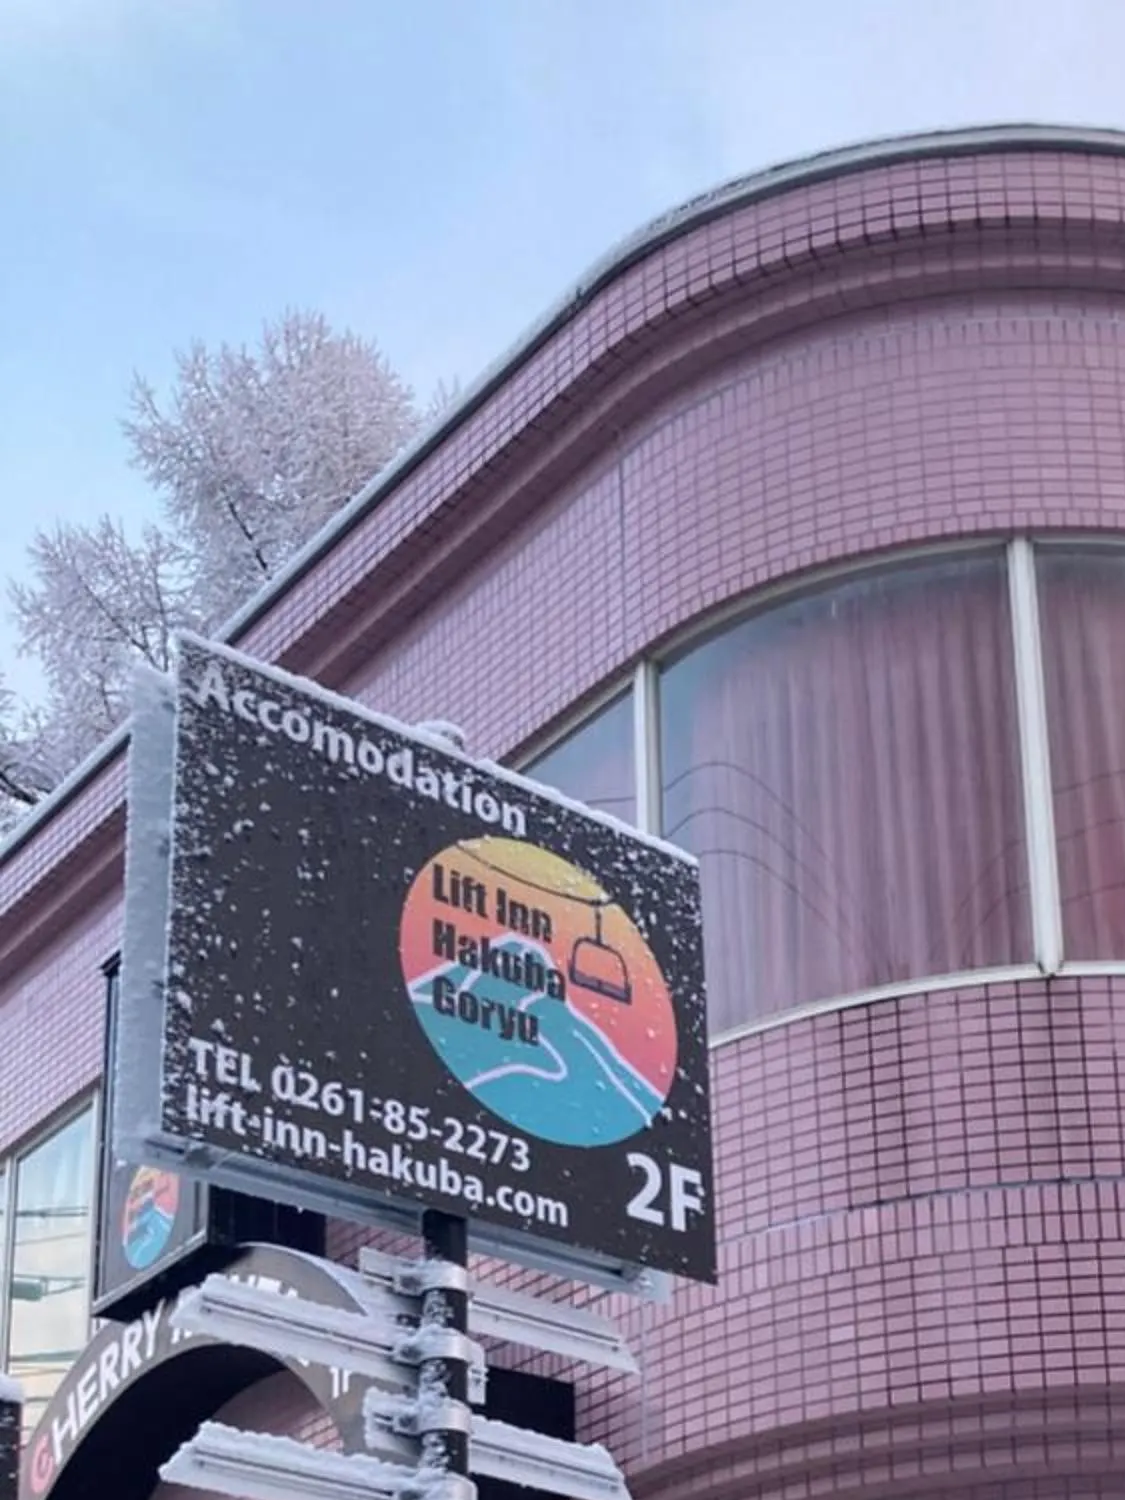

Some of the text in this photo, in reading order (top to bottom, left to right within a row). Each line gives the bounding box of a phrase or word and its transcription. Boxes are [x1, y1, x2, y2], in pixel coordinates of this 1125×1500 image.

[198, 658, 527, 837] Accomodation
[433, 863, 553, 944] Lift Inn
[432, 918, 567, 1002] Hakuba
[432, 975, 540, 1046] Goryu
[187, 1037, 531, 1172] TEL 0261-85-2273
[186, 1084, 569, 1228] lift-inn-hakuba.com
[626, 1152, 702, 1233] 2F
